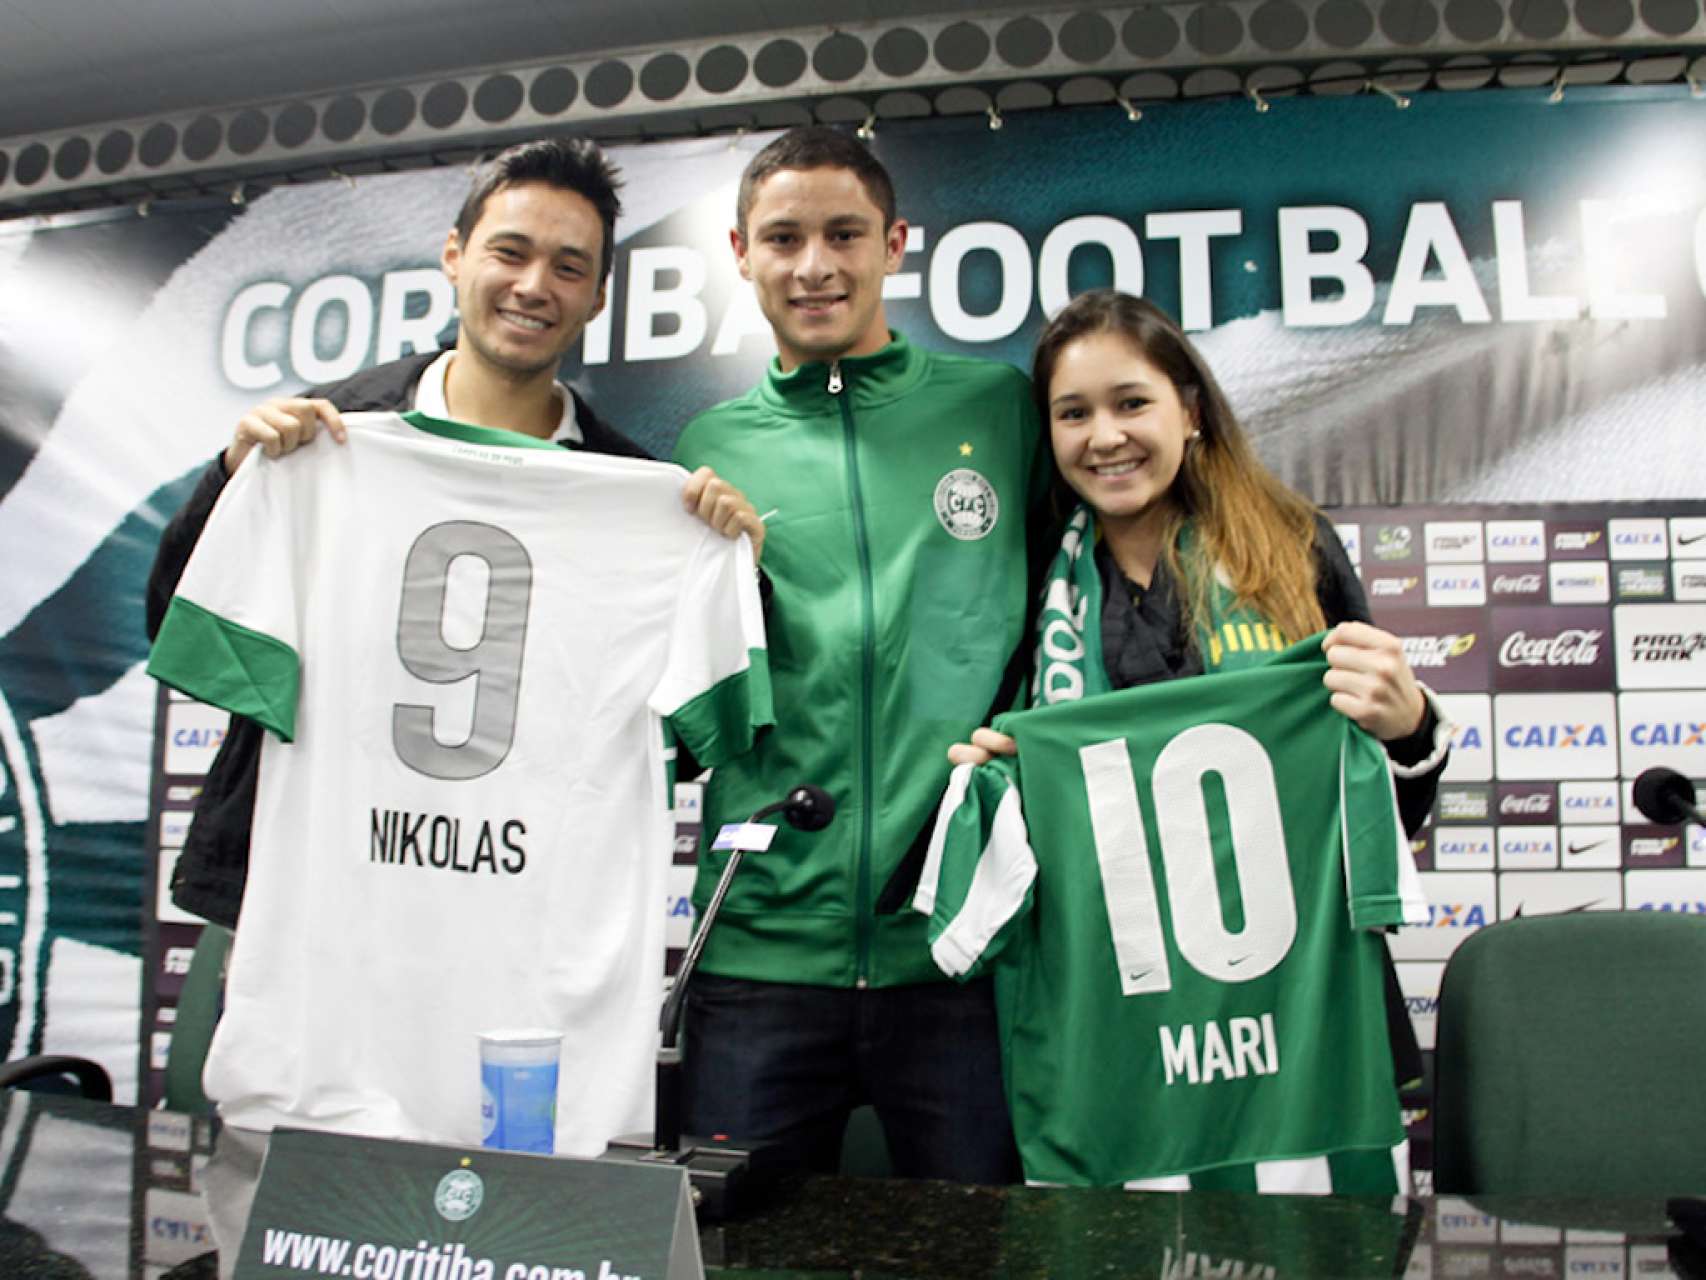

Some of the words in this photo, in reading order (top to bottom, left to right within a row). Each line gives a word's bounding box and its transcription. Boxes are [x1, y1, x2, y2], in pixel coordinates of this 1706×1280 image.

[222, 246, 772, 390] CORIBA
[1278, 200, 1668, 326] BALL
[392, 519, 533, 781] 9
[174, 728, 228, 748] CAIX
[1504, 724, 1608, 749] CAIXA
[1629, 722, 1706, 747] CAIX
[1565, 796, 1614, 808] CAIXA
[370, 808, 527, 875] NIKOLAS
[1440, 843, 1489, 855] CAIXA
[1503, 842, 1553, 854] CAIXA
[1078, 722, 1298, 996] 10
[1158, 1012, 1279, 1085] MARI
